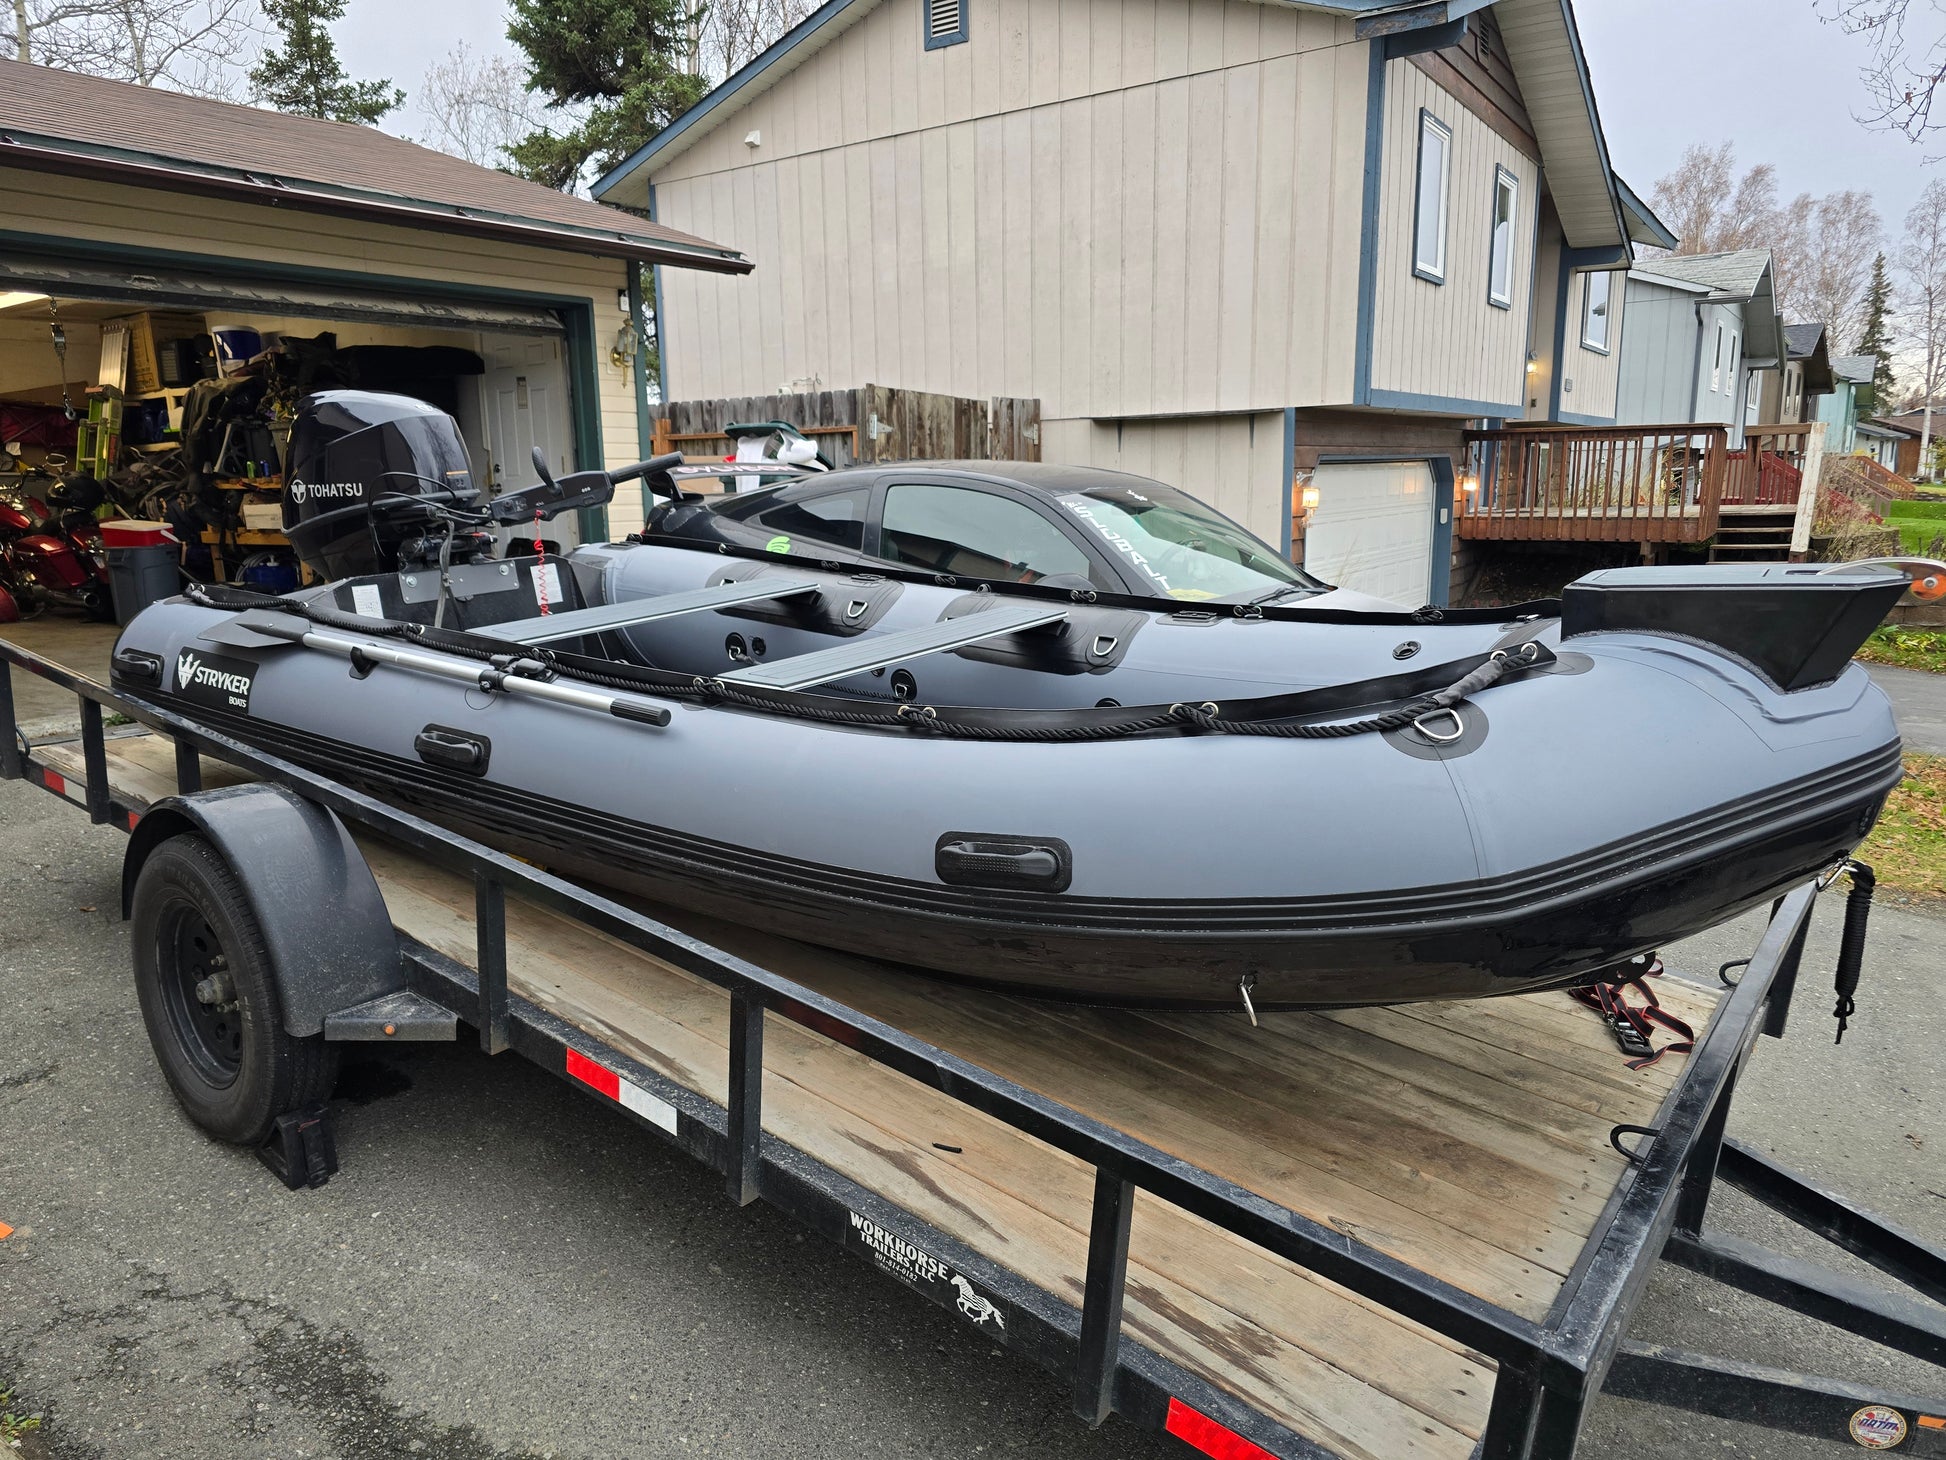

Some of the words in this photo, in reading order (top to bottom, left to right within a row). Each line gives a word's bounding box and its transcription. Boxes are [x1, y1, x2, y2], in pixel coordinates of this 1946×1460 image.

[308, 482, 363, 498] TOHATSU
[194, 666, 250, 695] STRYKER
[228, 695, 247, 708] BOATS
[849, 1210, 949, 1280] WORKHORSE
[914, 1262, 935, 1283] LLC
